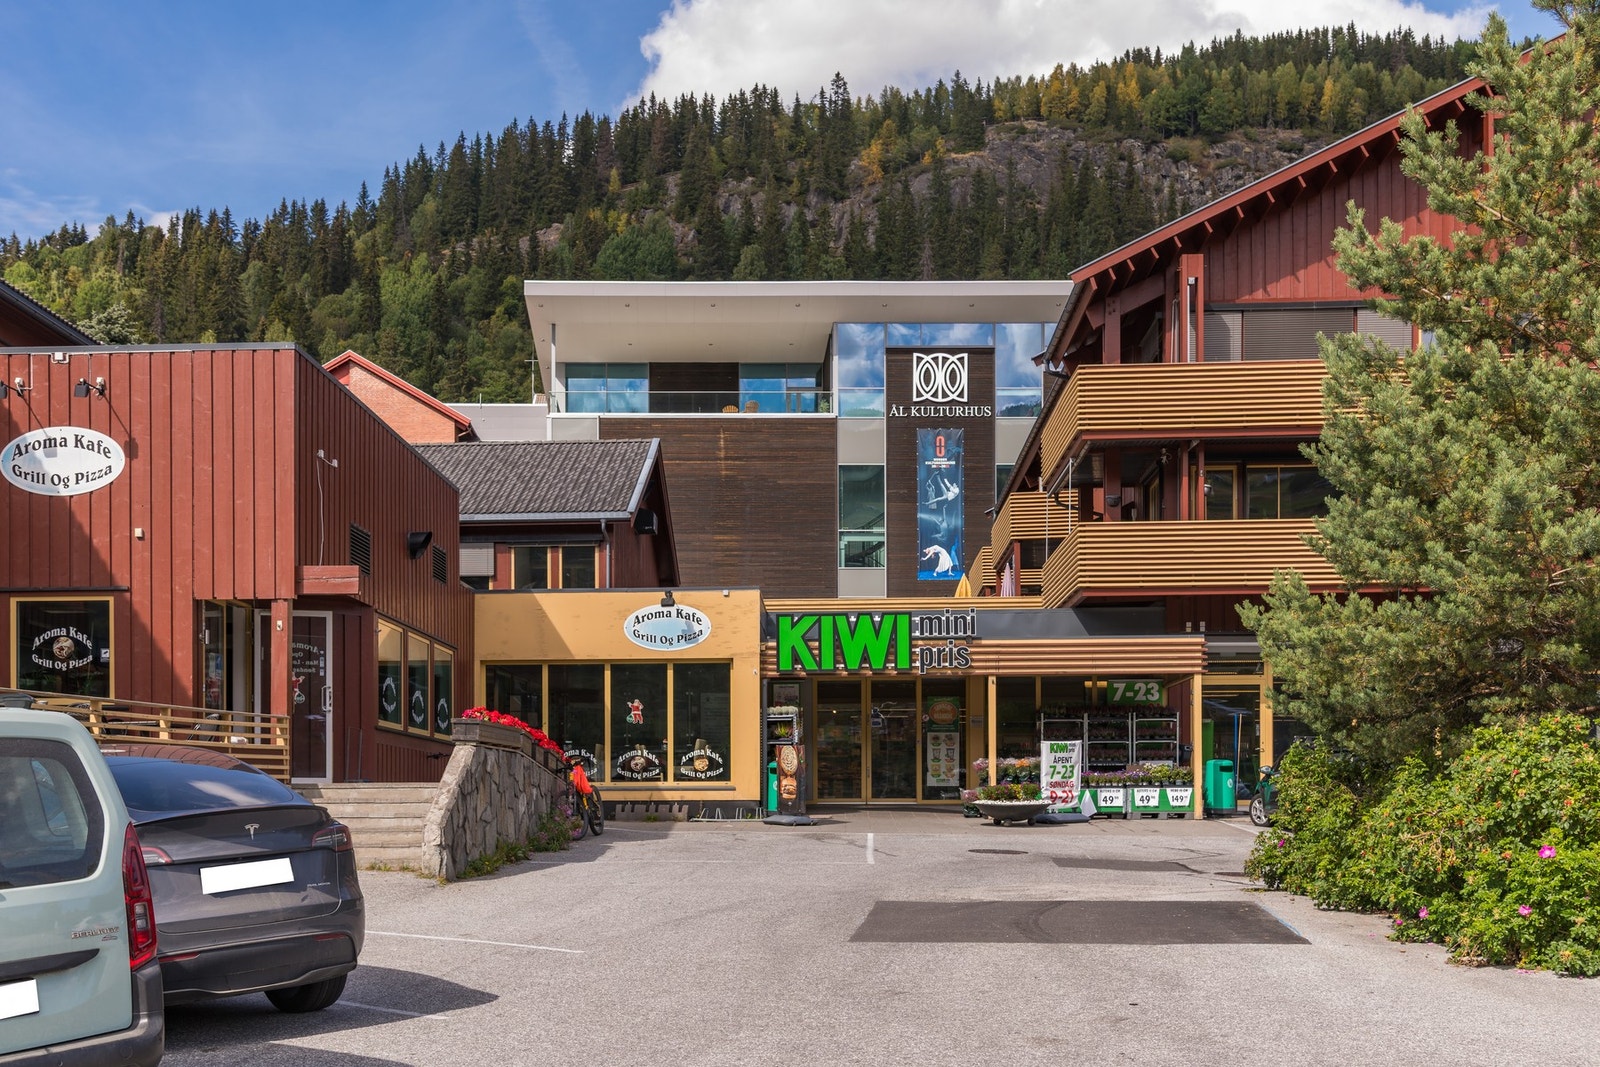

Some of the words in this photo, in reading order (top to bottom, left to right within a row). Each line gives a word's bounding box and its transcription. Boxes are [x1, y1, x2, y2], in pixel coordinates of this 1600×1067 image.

[889, 404, 908, 417] ÅL
[911, 405, 992, 417] KULTURHUS
[12, 436, 68, 461] Aroma
[73, 433, 112, 459] Kafe
[12, 464, 46, 485] Grill
[50, 473, 70, 489] Og
[74, 464, 113, 485] Pizza
[632, 610, 672, 628] Aroma
[675, 608, 703, 626] Kafe
[919, 608, 976, 637] mini
[31, 627, 67, 651] Aroma
[68, 626, 93, 650] Kafe
[632, 629, 657, 644] Grill
[659, 635, 674, 646] Og
[677, 629, 703, 644] Pizza
[777, 612, 912, 672] KIWI
[31, 654, 53, 669] Grill
[54, 661, 68, 671] Og
[69, 654, 93, 669] Pizza
[919, 639, 972, 674] pris
[1113, 682, 1160, 701] 7-23
[680, 749, 705, 766] Aroma
[706, 748, 723, 764] Kafe
[1049, 743, 1069, 754] KIWI
[617, 750, 642, 765] Aroma
[643, 749, 660, 766] Kafe
[1053, 755, 1073, 763] ÅPENT
[616, 767, 632, 778] Grill
[632, 772, 642, 780] Og
[642, 768, 660, 778] Pizza
[680, 767, 696, 778] Grill
[696, 771, 705, 779] Og
[706, 767, 724, 778] Pizza
[1049, 764, 1075, 779] 7-23
[1049, 780, 1075, 788] SØNDAG
[1102, 795, 1114, 804] 49
[1139, 795, 1150, 804] 49
[1171, 795, 1184, 803] 149
